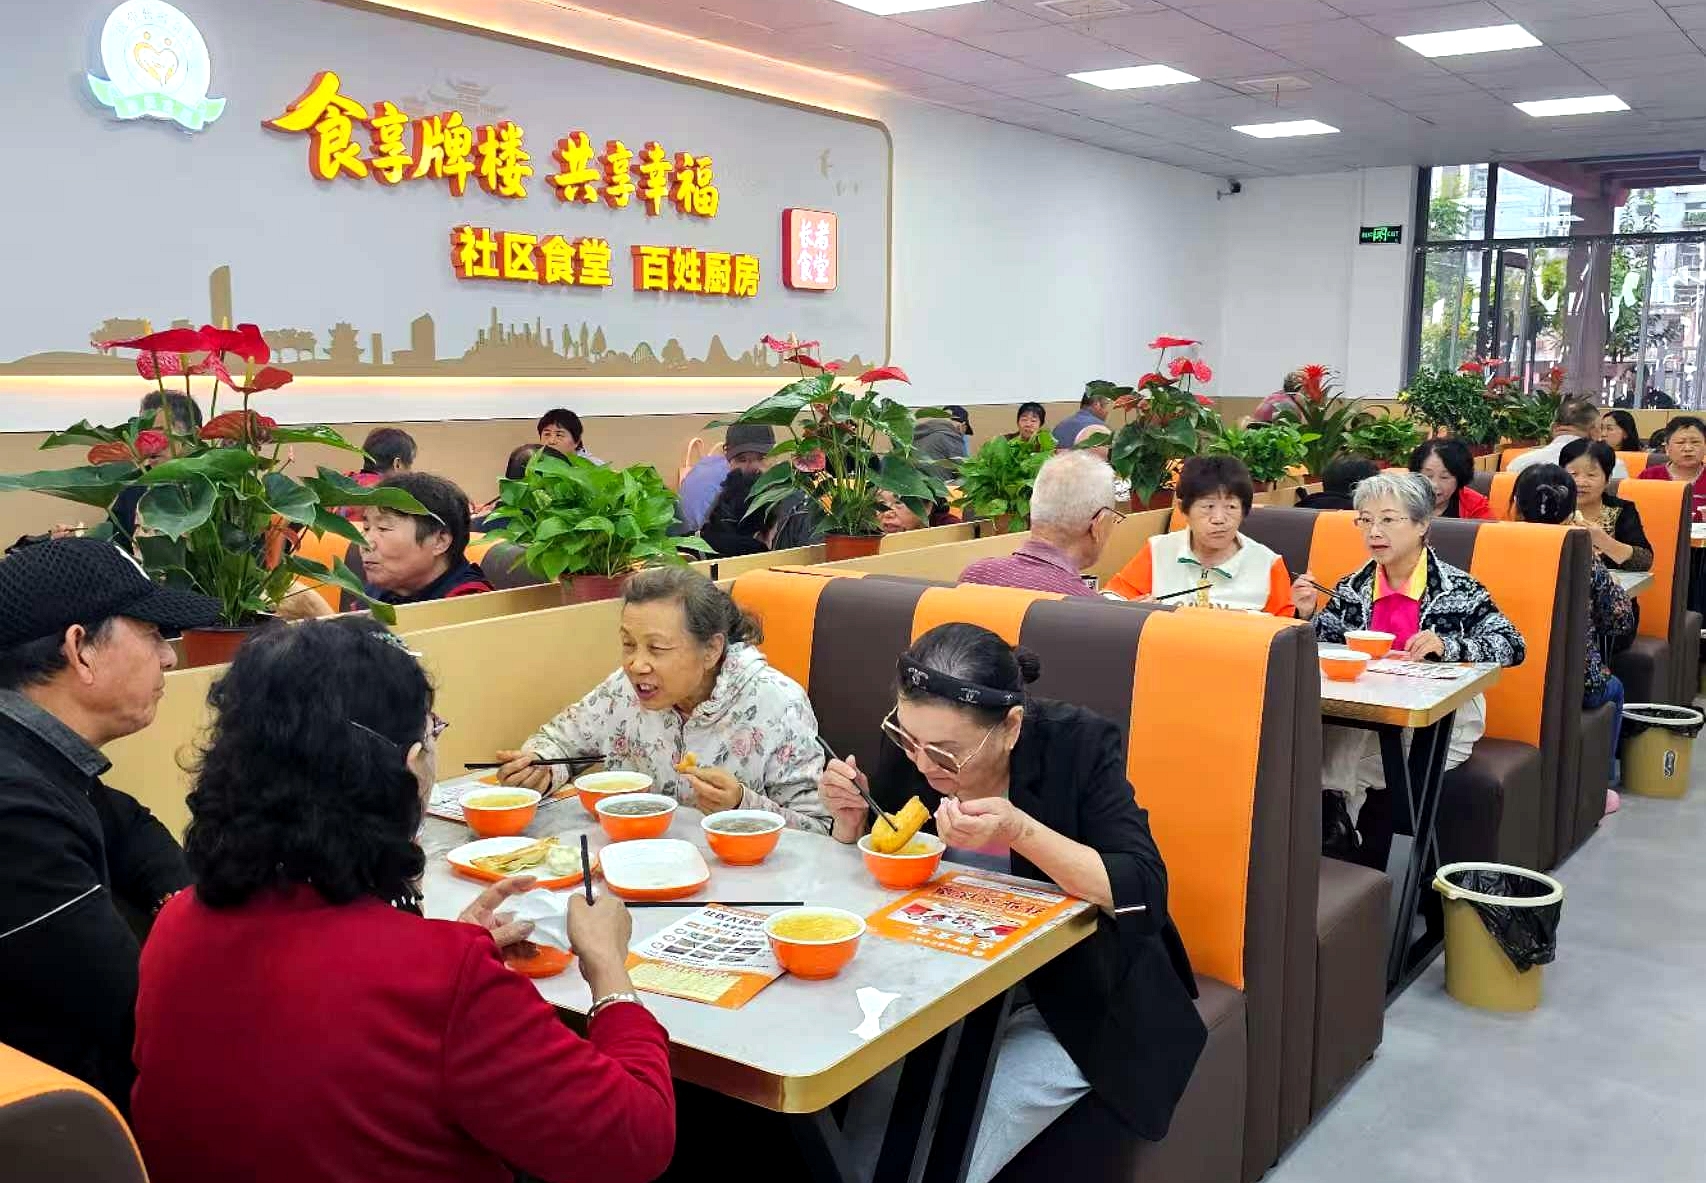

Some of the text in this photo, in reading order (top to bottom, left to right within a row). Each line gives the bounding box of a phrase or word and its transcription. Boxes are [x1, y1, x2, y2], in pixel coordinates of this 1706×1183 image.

[262, 71, 719, 219] 食享牌楼 共享幸福
[451, 225, 760, 297] 社区食堂 百姓厨房
[797, 250, 830, 283] 食堂
